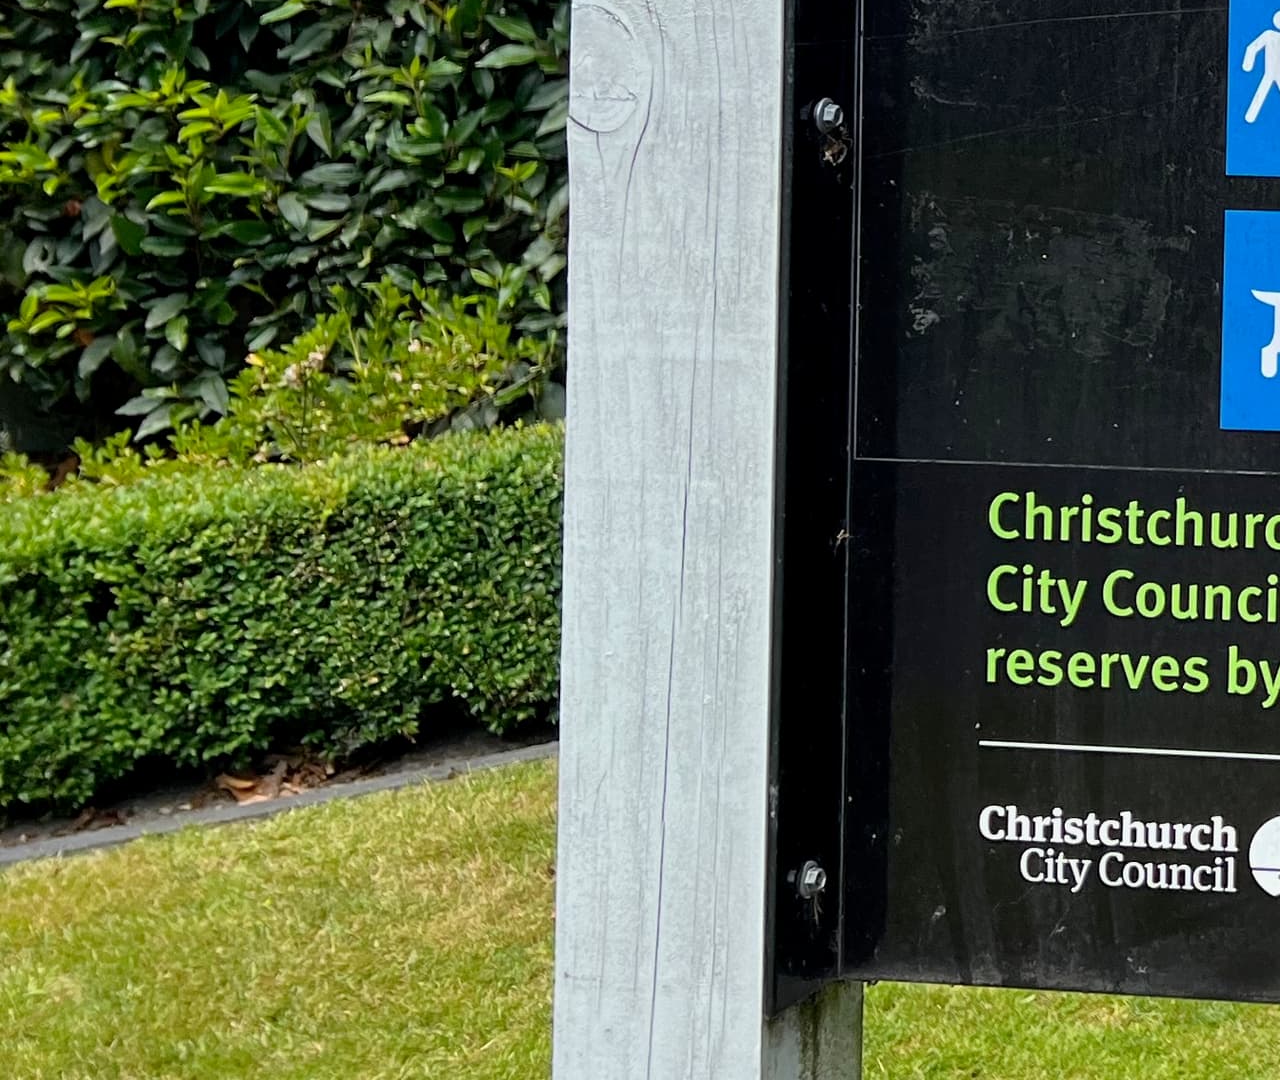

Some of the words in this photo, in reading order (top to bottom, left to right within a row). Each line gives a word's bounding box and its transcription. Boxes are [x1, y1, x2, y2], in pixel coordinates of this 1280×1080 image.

[988, 565, 1087, 626] City
[987, 649, 1208, 692] reserves
[980, 806, 1238, 852] Christchurch
[1021, 848, 1091, 892] City
[1099, 852, 1236, 892] Council
